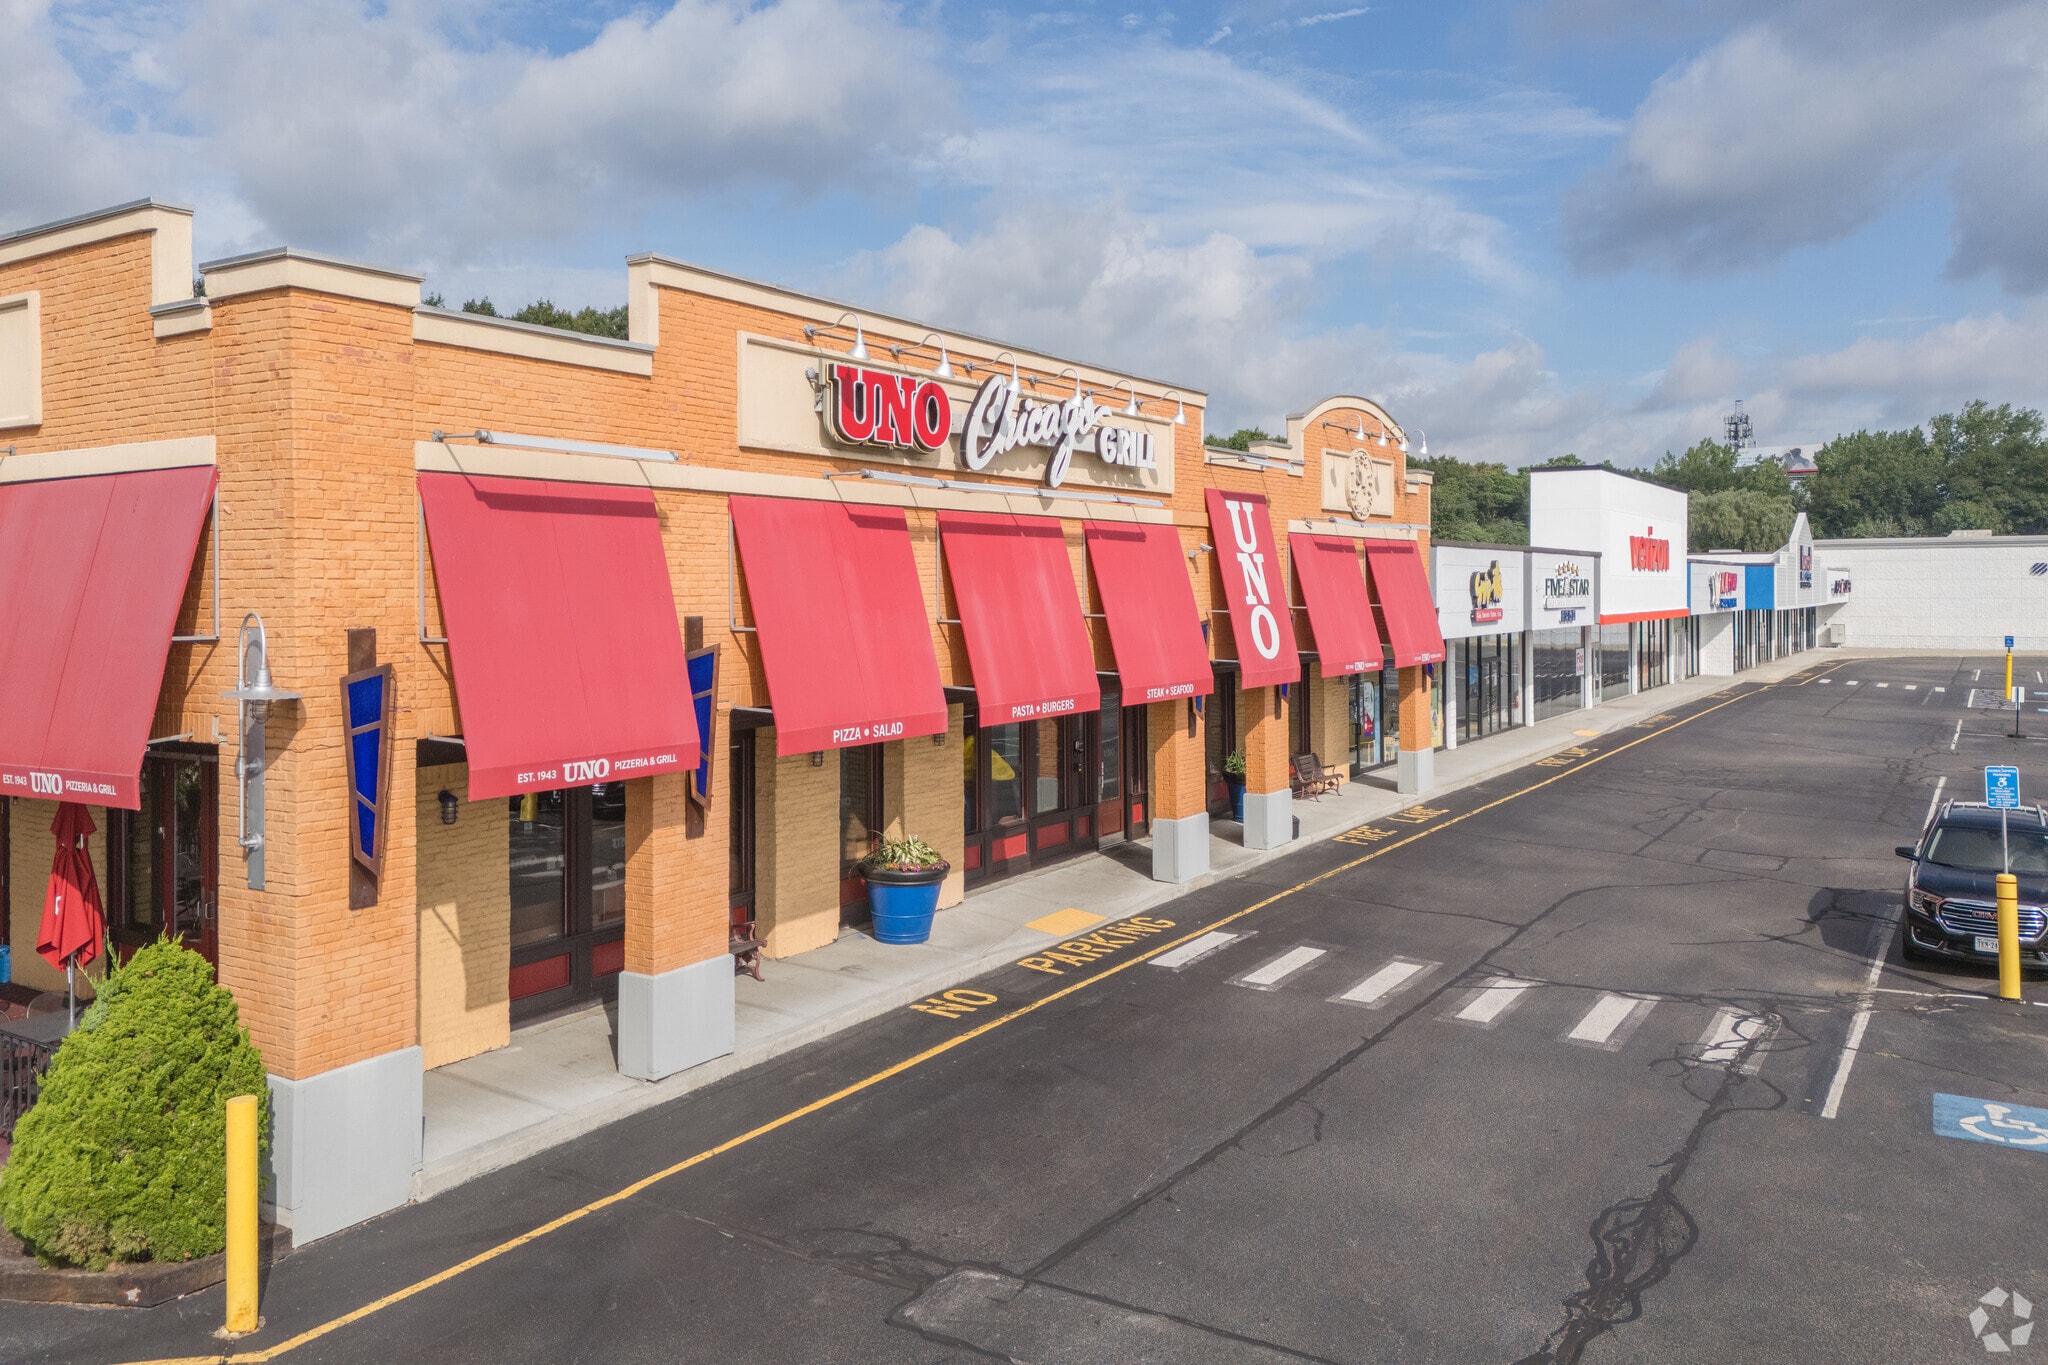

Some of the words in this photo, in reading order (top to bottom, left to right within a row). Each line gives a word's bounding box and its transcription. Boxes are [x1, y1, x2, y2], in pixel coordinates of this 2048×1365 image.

[833, 363, 952, 450] UNO
[961, 374, 1113, 488] Chicago
[1098, 425, 1158, 469] GRILL
[1225, 499, 1281, 660] UNO
[1569, 577, 1590, 597] STAR
[1147, 687, 1165, 699] STEAK
[1170, 683, 1194, 696] SEAFOOD
[1012, 704, 1034, 718] PASTA
[1042, 699, 1074, 714] BURGERS
[833, 727, 861, 744] PIZZA
[872, 721, 903, 738] SALAD
[518, 773, 535, 784] EST.
[537, 770, 557, 781] 1943
[563, 758, 609, 783] UNO
[614, 760, 648, 771] PIZZERIA
[656, 753, 677, 764] GRILL
[3, 774, 14, 785] EST.
[14, 776, 27, 786] 1943
[30, 772, 63, 795] UNO
[65, 780, 92, 793] PIZZERIA
[98, 783, 117, 796] GRILL
[1332, 825, 1398, 846] FIRE
[909, 989, 998, 1019] NO
[1016, 916, 1177, 975] PARKING
